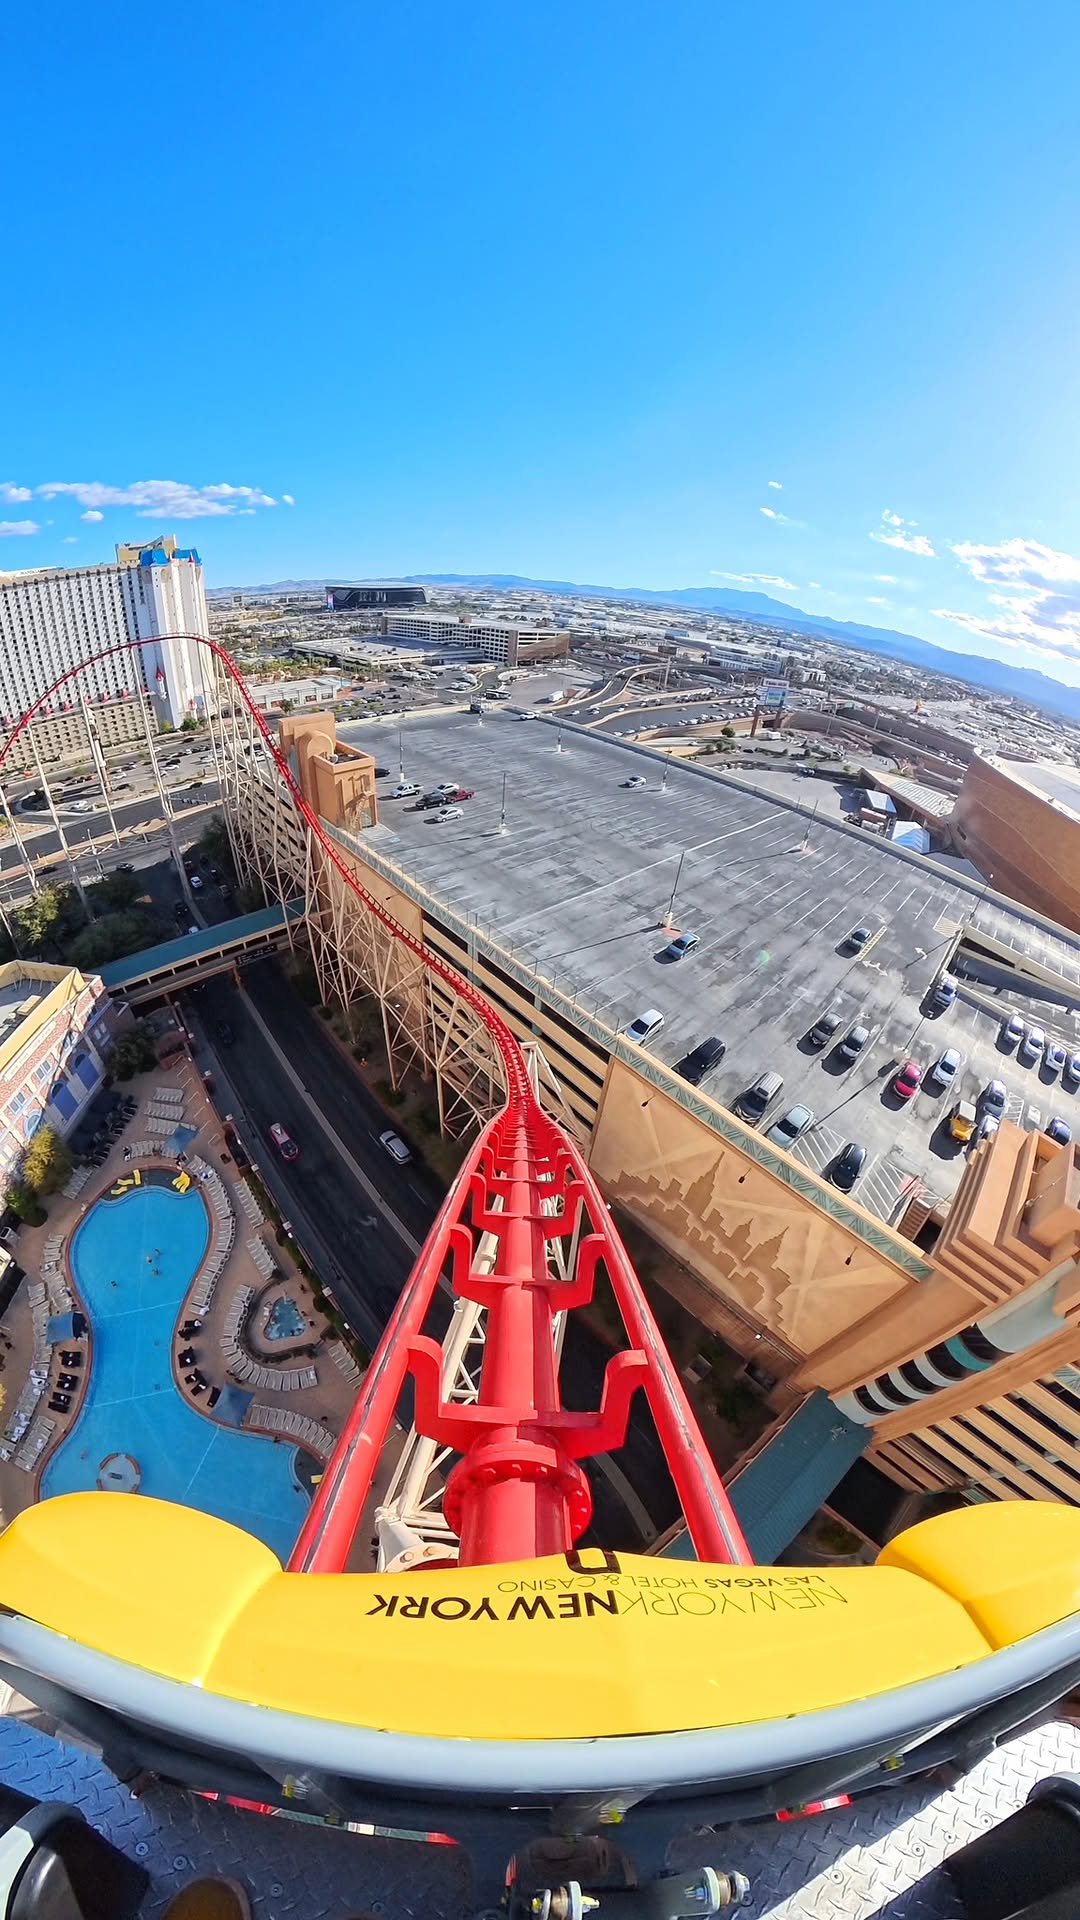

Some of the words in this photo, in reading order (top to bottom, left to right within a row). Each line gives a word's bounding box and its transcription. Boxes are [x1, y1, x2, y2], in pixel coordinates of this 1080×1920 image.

[497, 1575, 597, 1593] CASINO
[601, 1574, 620, 1586] &
[624, 1575, 698, 1588] HOTEL
[704, 1577, 784, 1589] VEGAS
[783, 1575, 826, 1586] LAS
[365, 1594, 499, 1621] YORK
[507, 1589, 619, 1621] NEW
[616, 1590, 746, 1616] YORK
[750, 1585, 848, 1612] NEW
